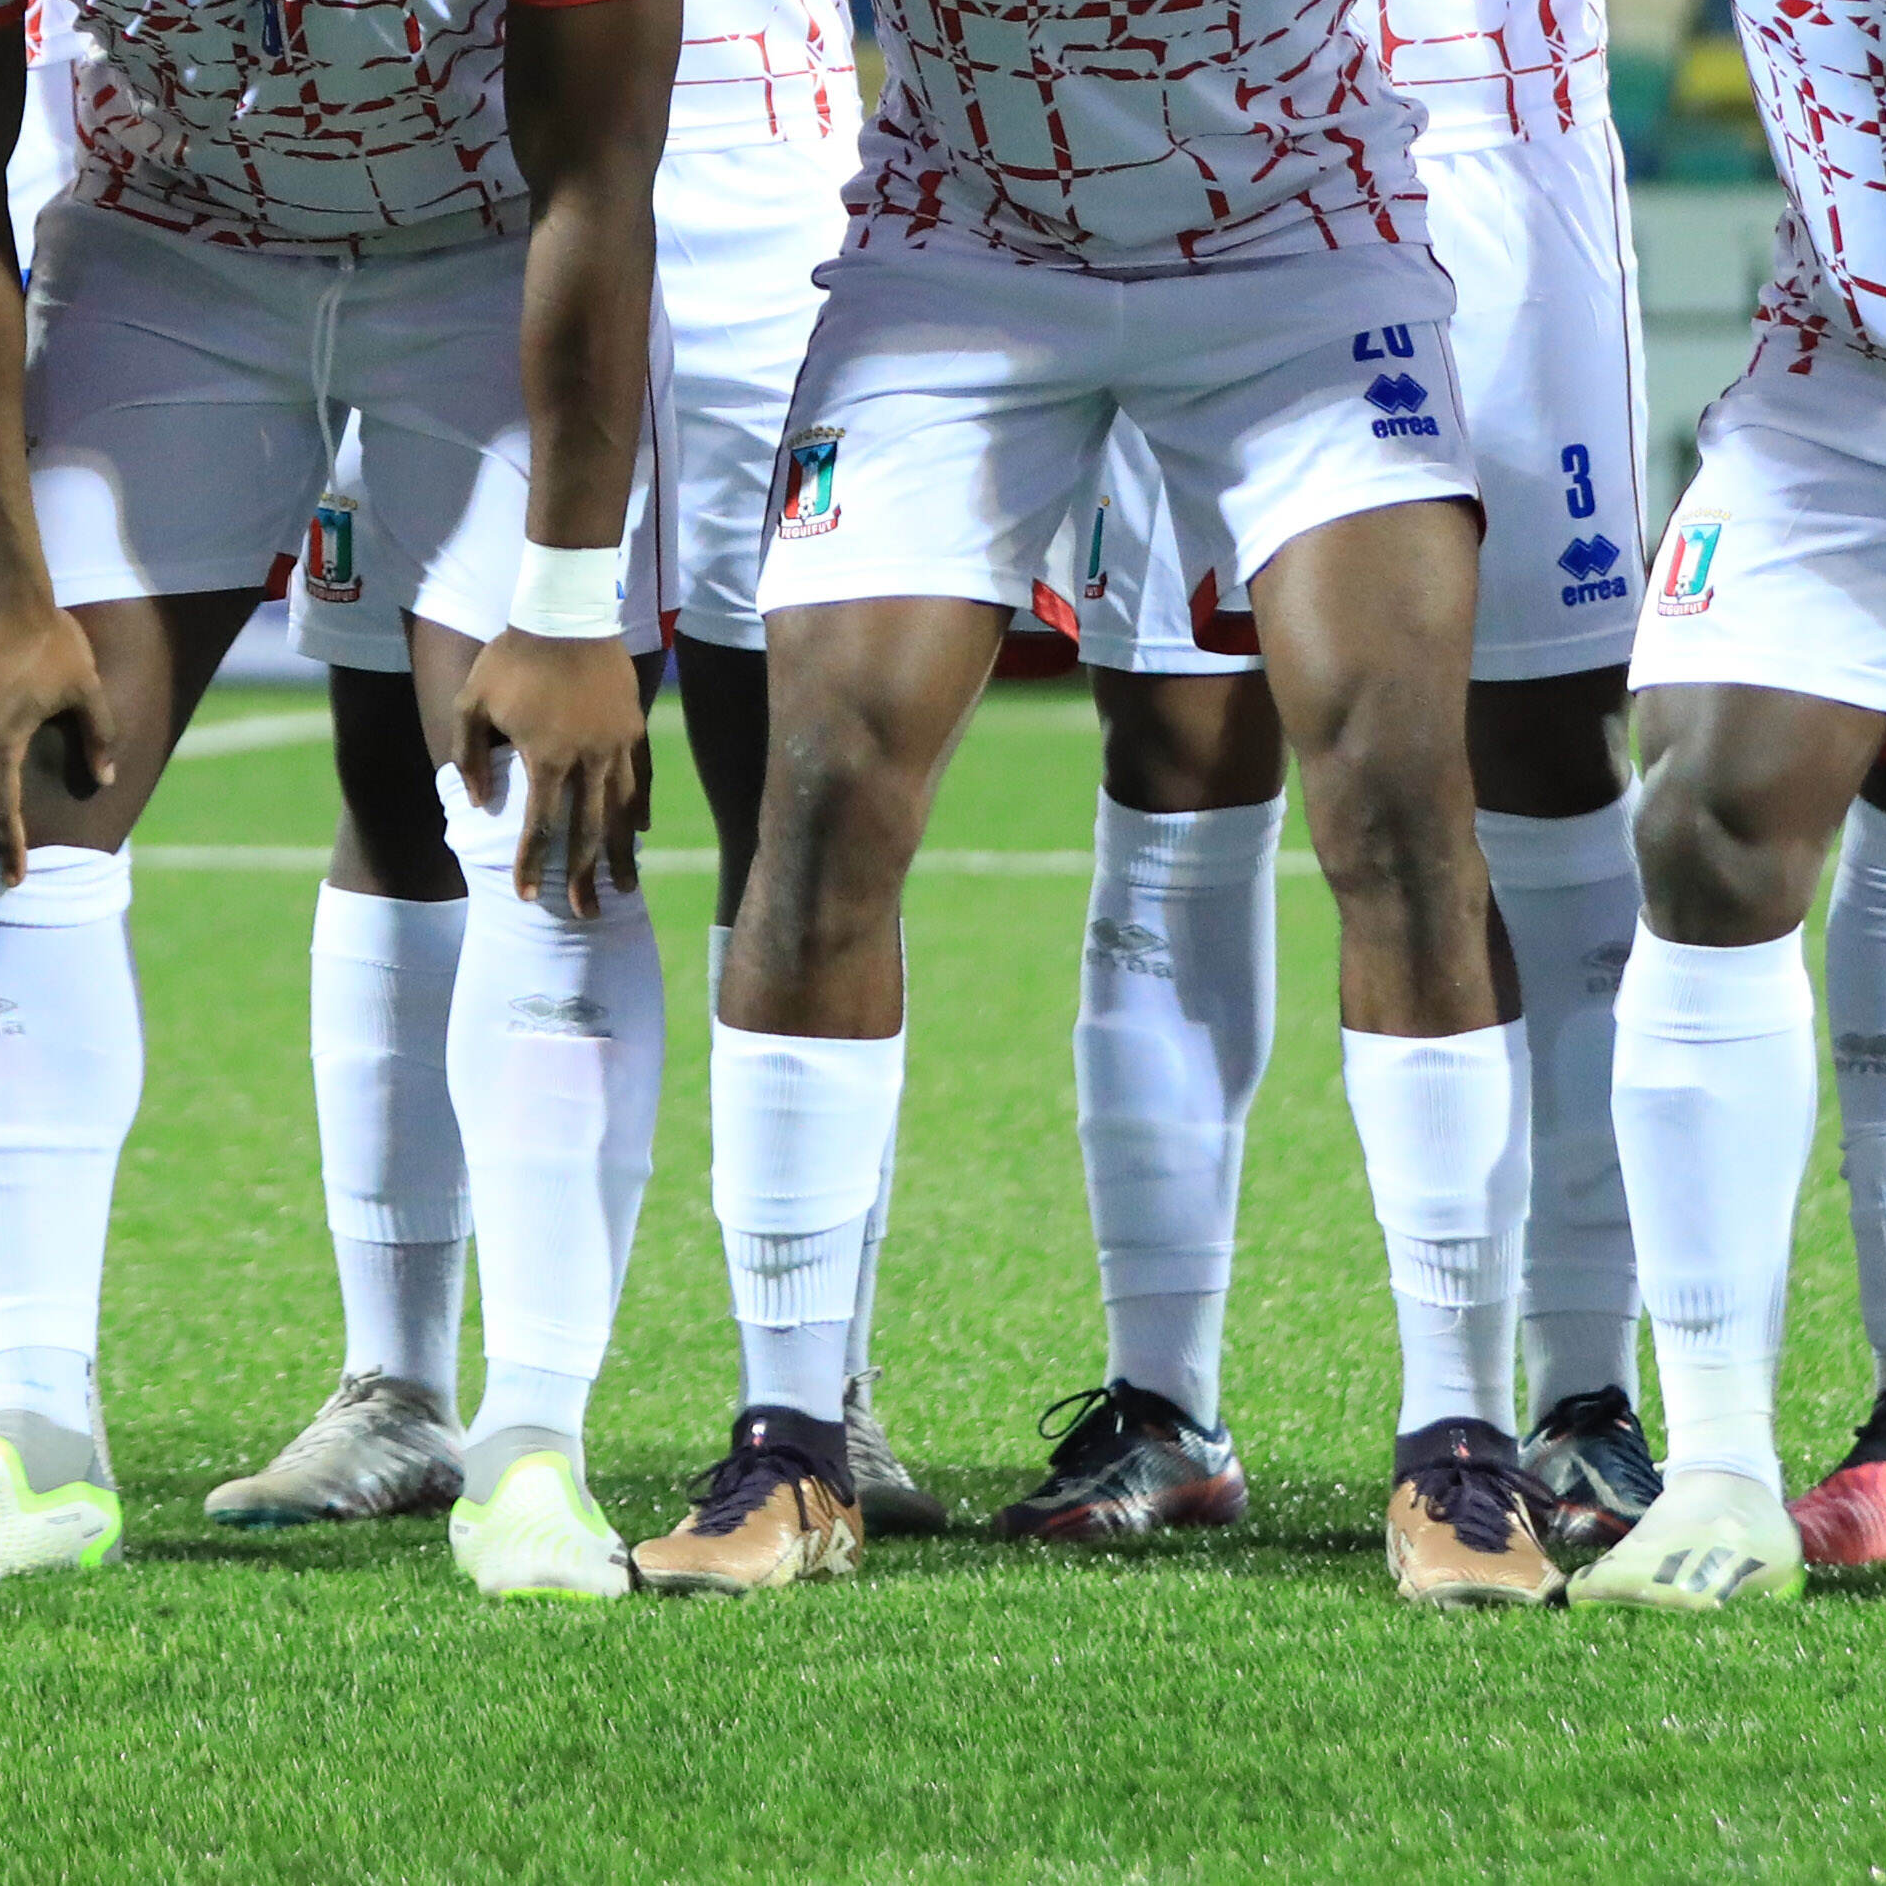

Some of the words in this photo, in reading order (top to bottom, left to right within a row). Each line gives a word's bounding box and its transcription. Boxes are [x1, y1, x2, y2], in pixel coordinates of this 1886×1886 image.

[1371, 415, 1440, 439] errea
[1561, 443, 1596, 519] 3
[1561, 576, 1627, 607] errea
